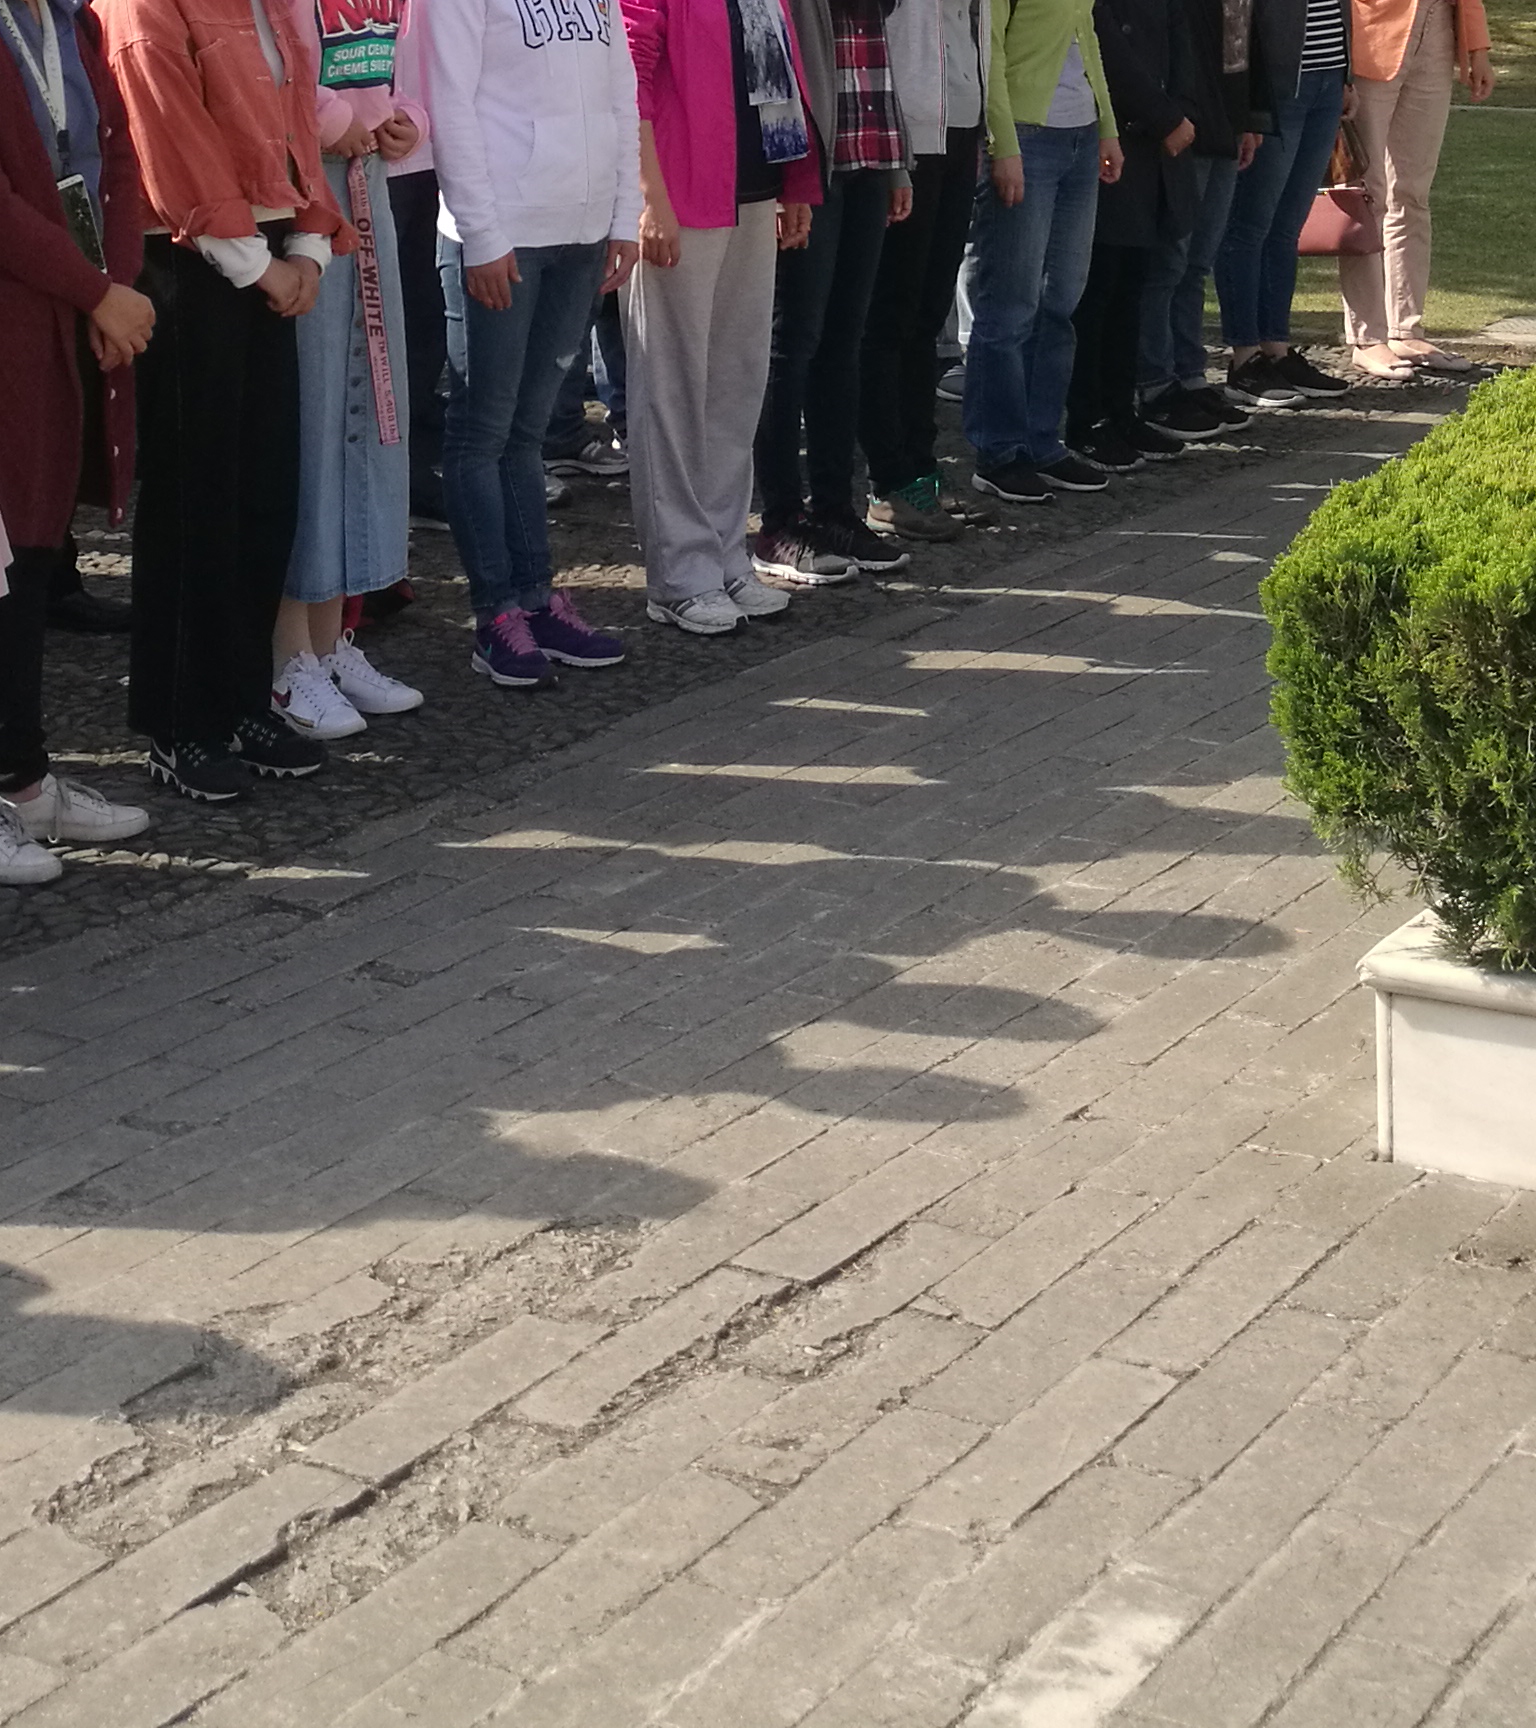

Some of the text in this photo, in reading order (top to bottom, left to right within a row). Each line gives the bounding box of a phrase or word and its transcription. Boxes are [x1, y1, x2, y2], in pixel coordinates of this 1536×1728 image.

[333, 45, 366, 62] SOUR
[357, 218, 384, 337] OFF-WHITE
[380, 358, 390, 383] WILL
